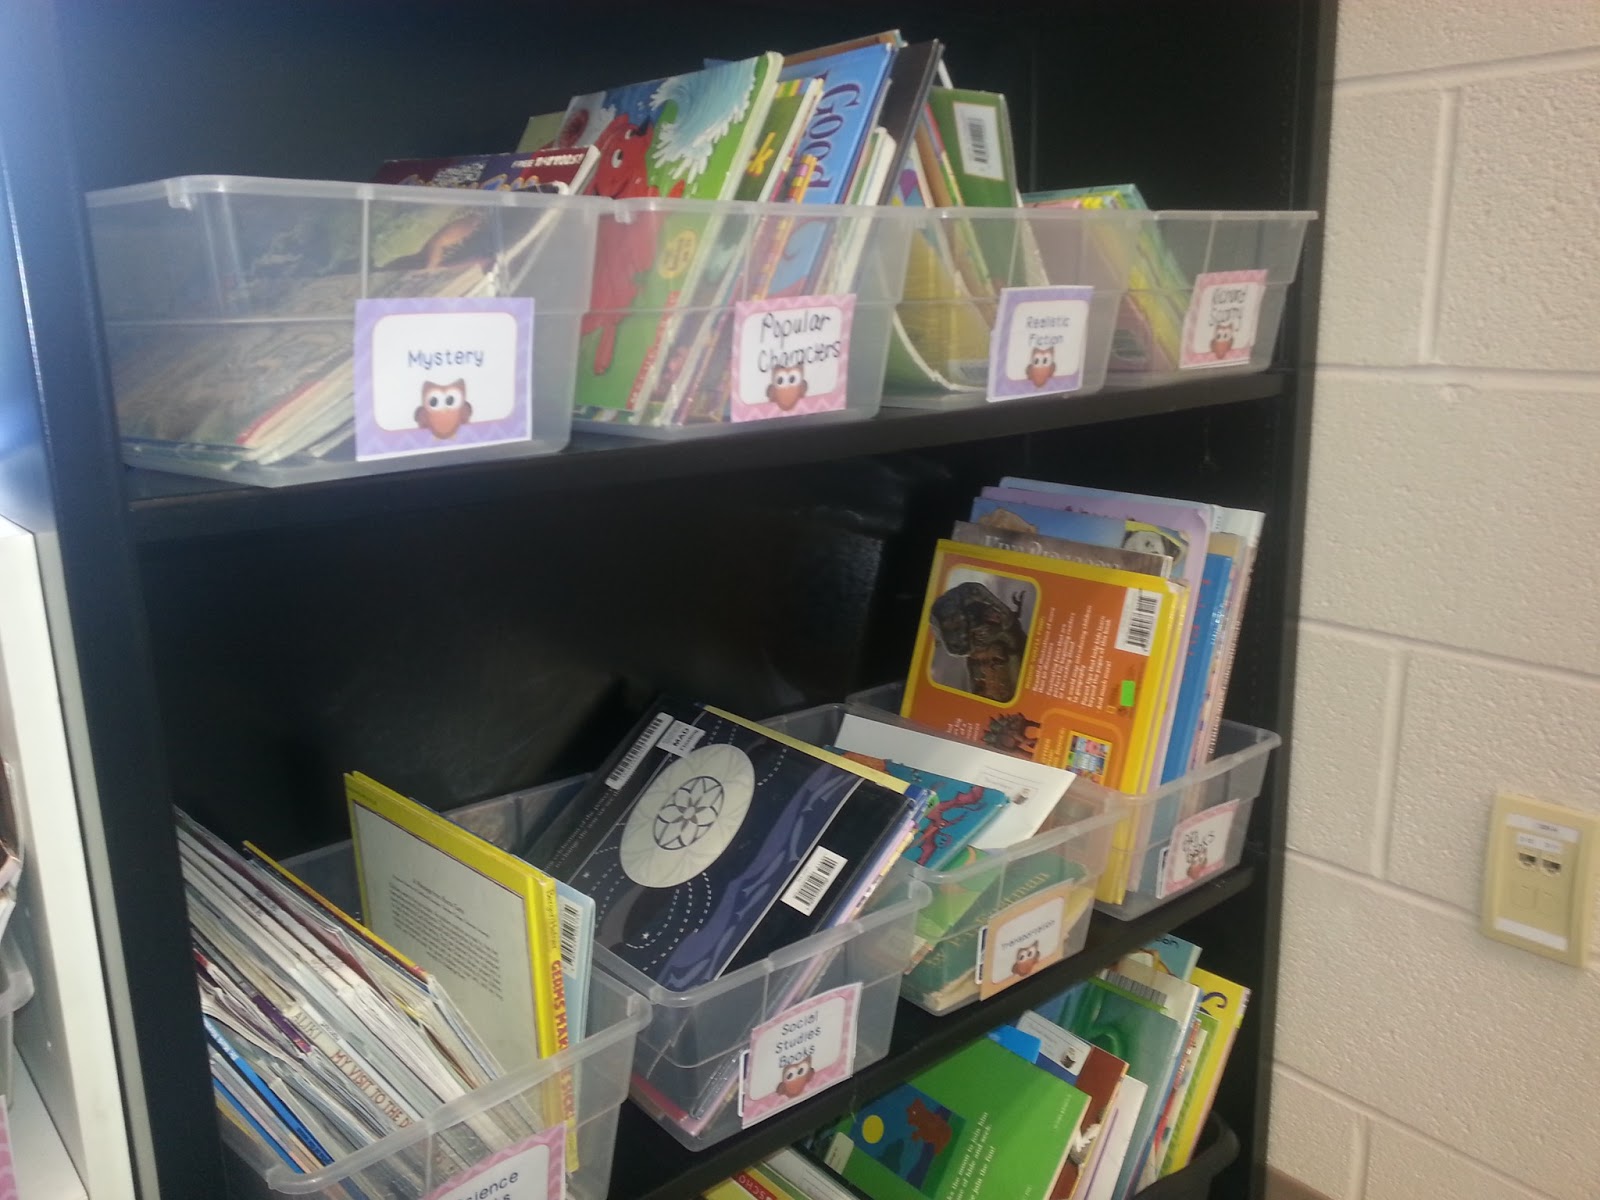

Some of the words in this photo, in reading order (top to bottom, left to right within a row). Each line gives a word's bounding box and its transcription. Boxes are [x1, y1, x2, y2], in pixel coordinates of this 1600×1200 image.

[759, 311, 832, 350] Popular
[407, 348, 485, 371] Mystery
[548, 961, 566, 1008] GERMS
[782, 1011, 818, 1035] Social
[775, 1026, 822, 1054] Studies
[292, 1010, 321, 1041] ALIKI
[330, 1049, 351, 1070] MY
[346, 1065, 374, 1092] VISIT
[369, 1088, 386, 1105] TO
[381, 1101, 403, 1121] THE
[958, 1154, 969, 1174] moon
